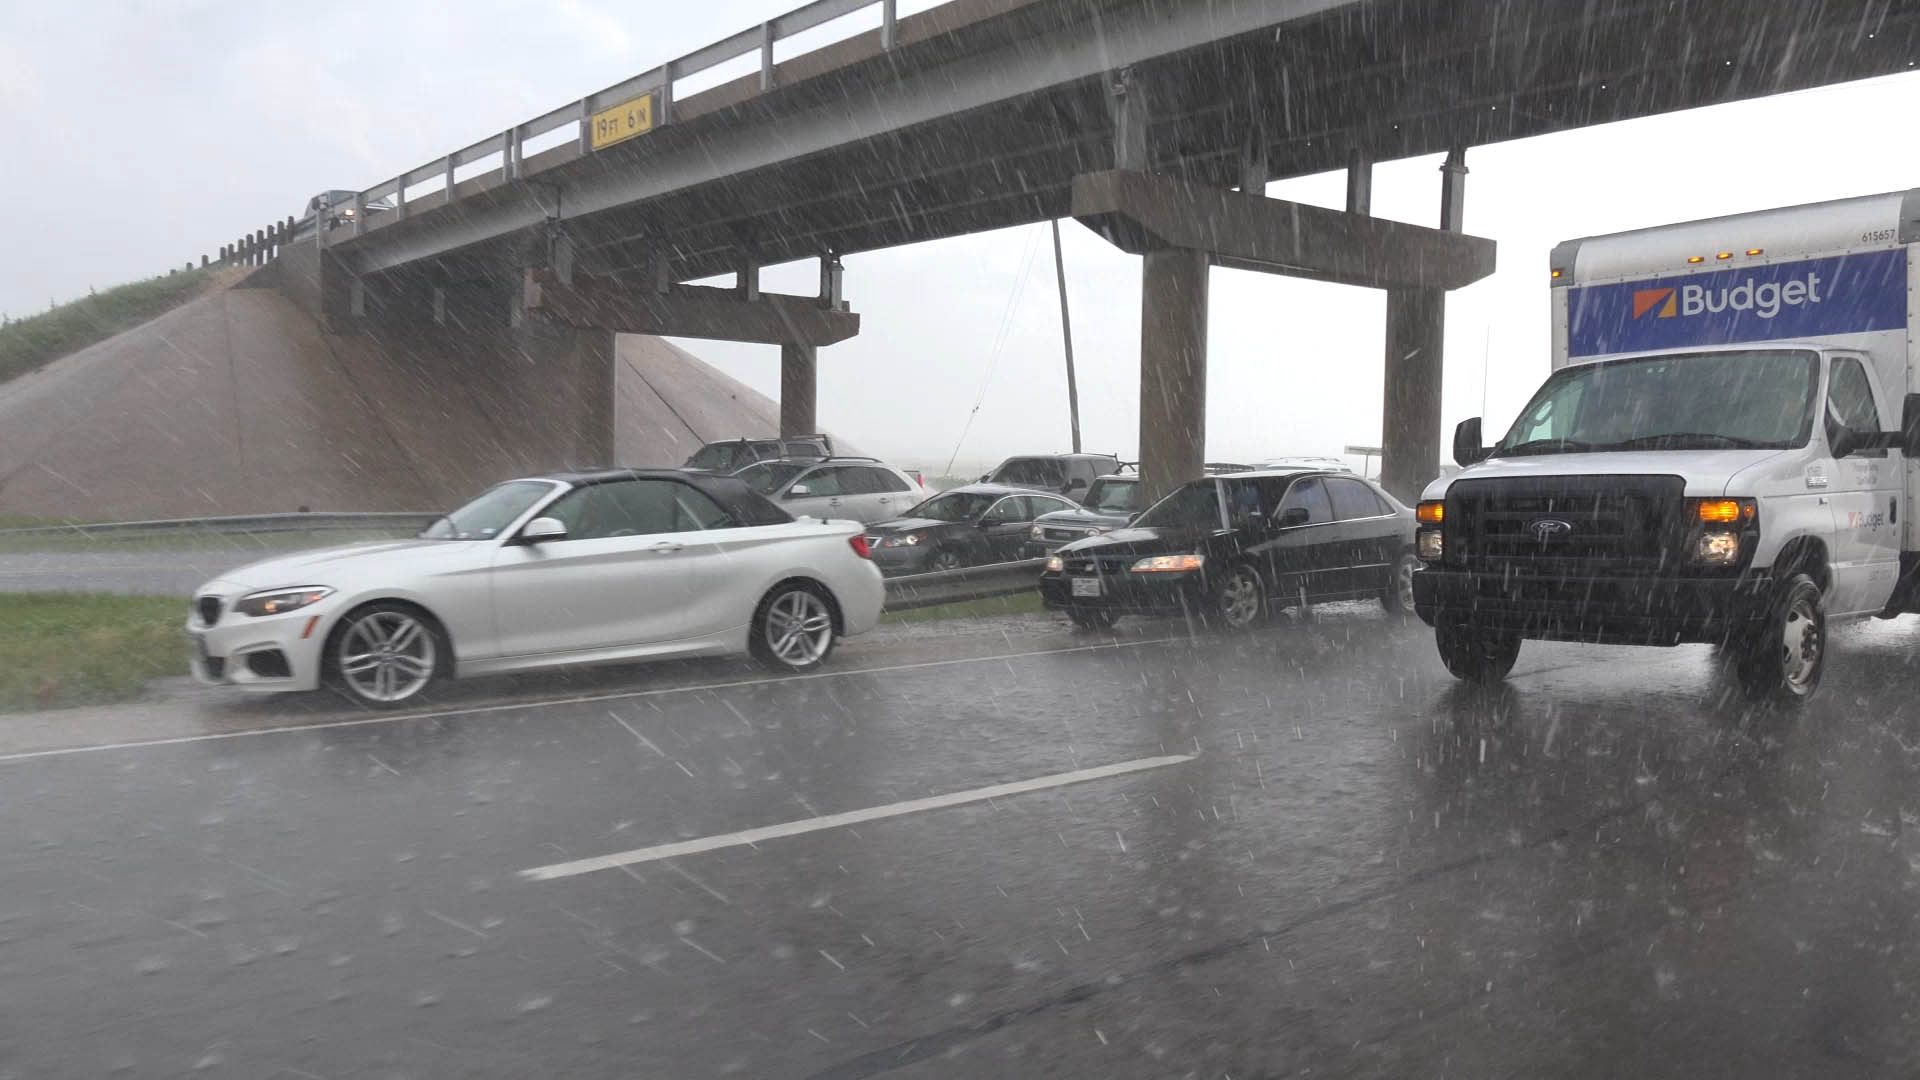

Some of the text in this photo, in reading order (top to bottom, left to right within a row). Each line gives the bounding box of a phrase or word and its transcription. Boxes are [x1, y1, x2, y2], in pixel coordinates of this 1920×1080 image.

[597, 118, 608, 140] 19
[628, 109, 637, 129] 6
[1862, 229, 1895, 242] 615657
[1682, 272, 1821, 319] Budget
